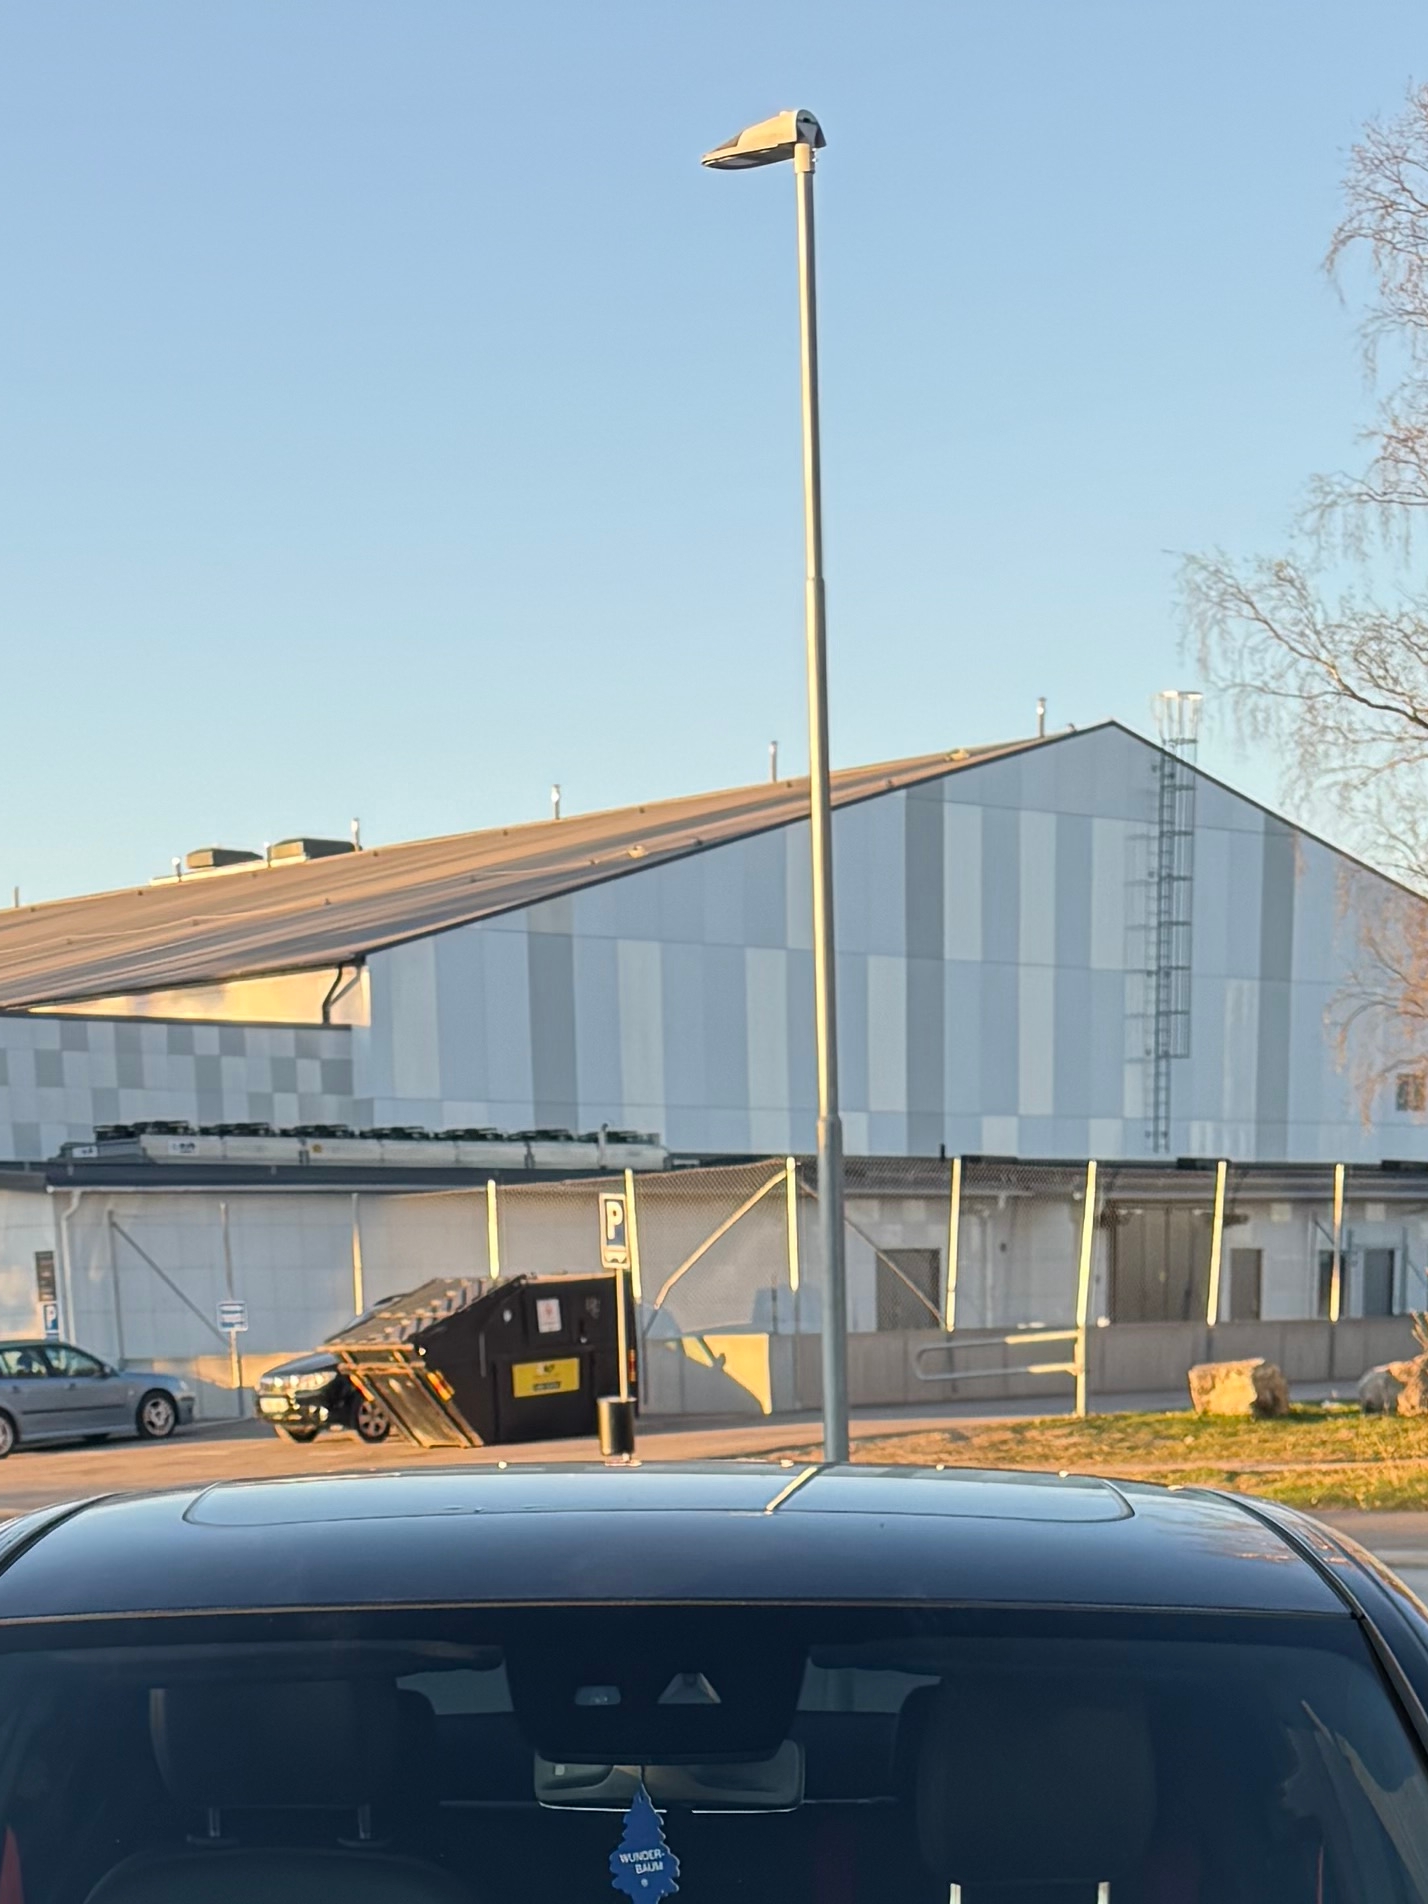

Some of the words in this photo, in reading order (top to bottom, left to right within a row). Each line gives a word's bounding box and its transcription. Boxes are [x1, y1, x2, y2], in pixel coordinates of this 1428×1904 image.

[606, 1201, 623, 1240] P
[619, 1848, 665, 1864] WUNDER-
[634, 1861, 664, 1875] BAUM
